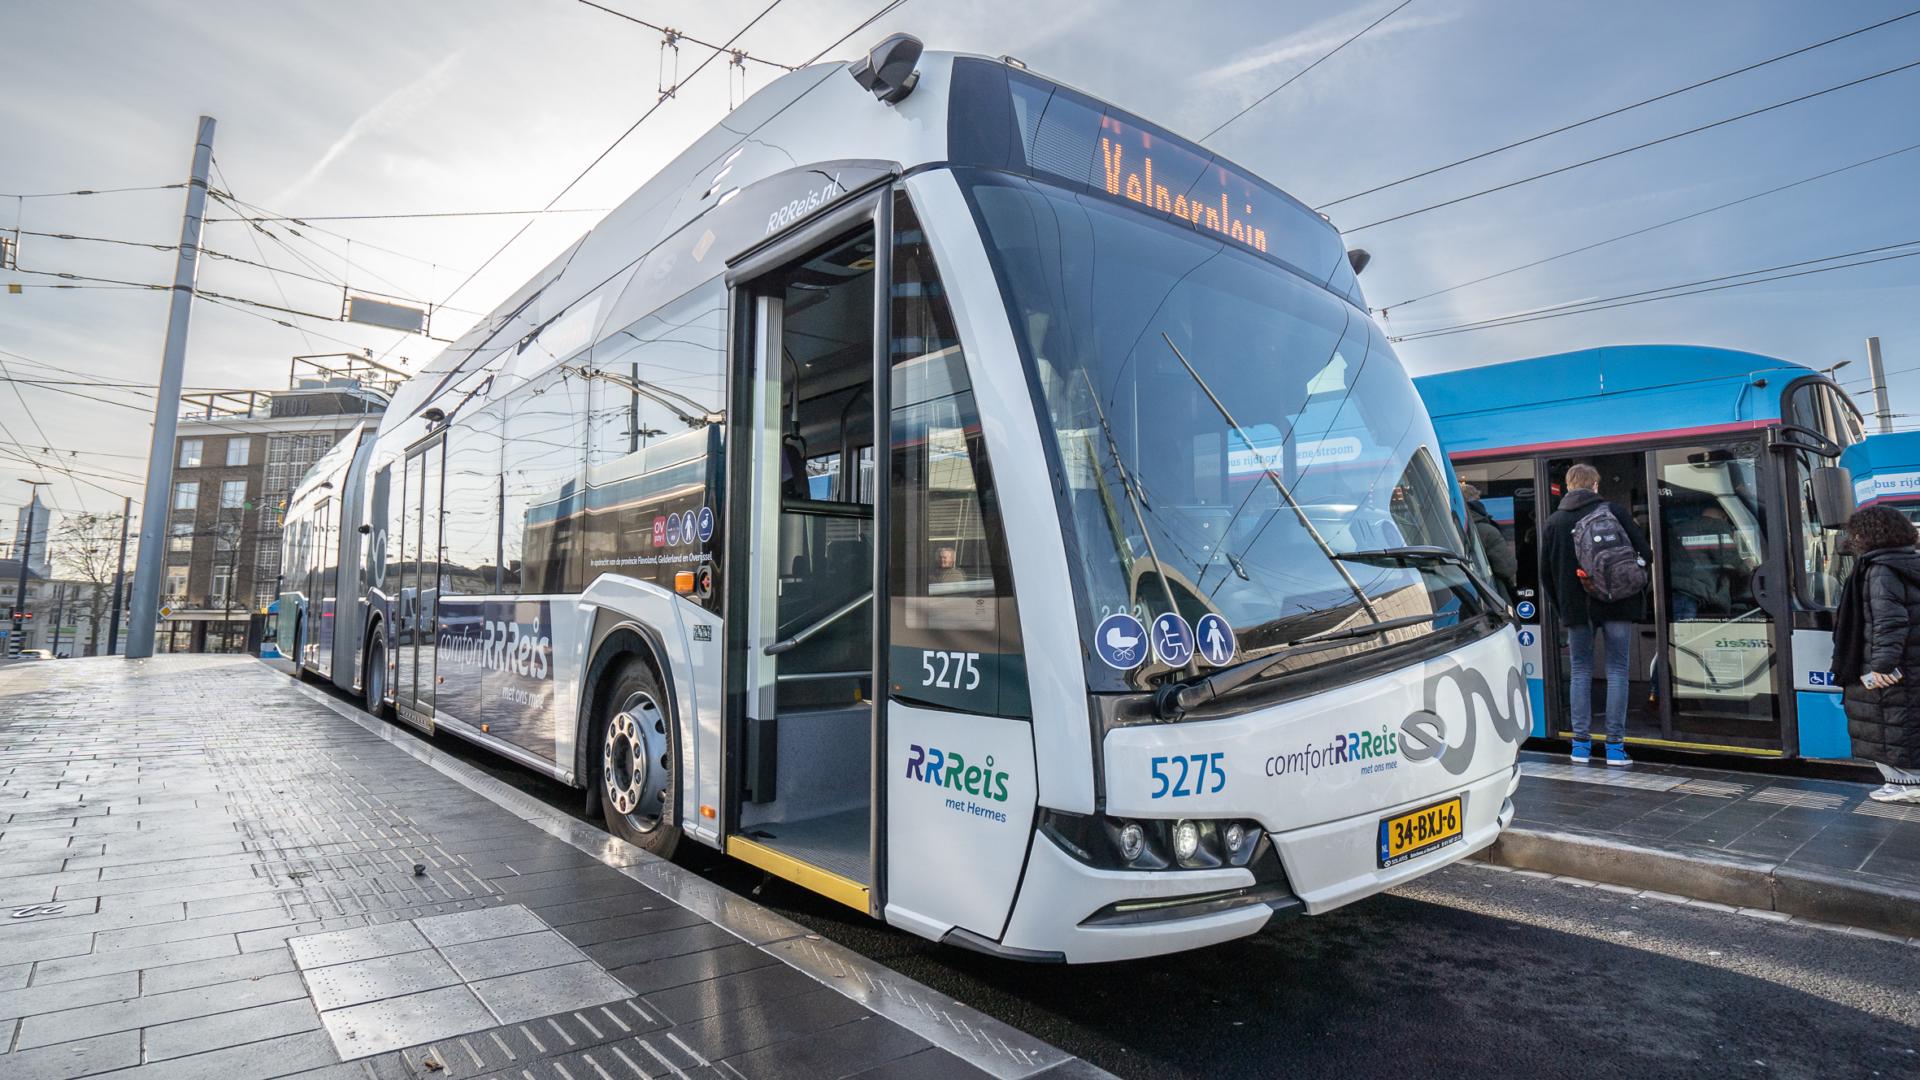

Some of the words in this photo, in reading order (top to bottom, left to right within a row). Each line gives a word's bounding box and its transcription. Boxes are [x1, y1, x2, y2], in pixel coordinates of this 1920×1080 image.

[766, 173, 840, 234] RRReis.nl
[654, 520, 665, 535] OV
[658, 553, 682, 564] Gelderland
[689, 550, 713, 563] Overijssel
[922, 650, 981, 691] 5275
[502, 685, 516, 701] met
[516, 689, 528, 705] ons
[1265, 724, 1398, 777] comfortRRReis
[1361, 765, 1374, 775] met
[1374, 763, 1385, 773] ons
[1386, 760, 1398, 771] mee
[906, 743, 1010, 802] RRReis
[1151, 752, 1226, 799] 5275
[945, 797, 965, 812] met
[967, 801, 1007, 823] Hermes
[1395, 805, 1457, 850] 34-BXJ-6
